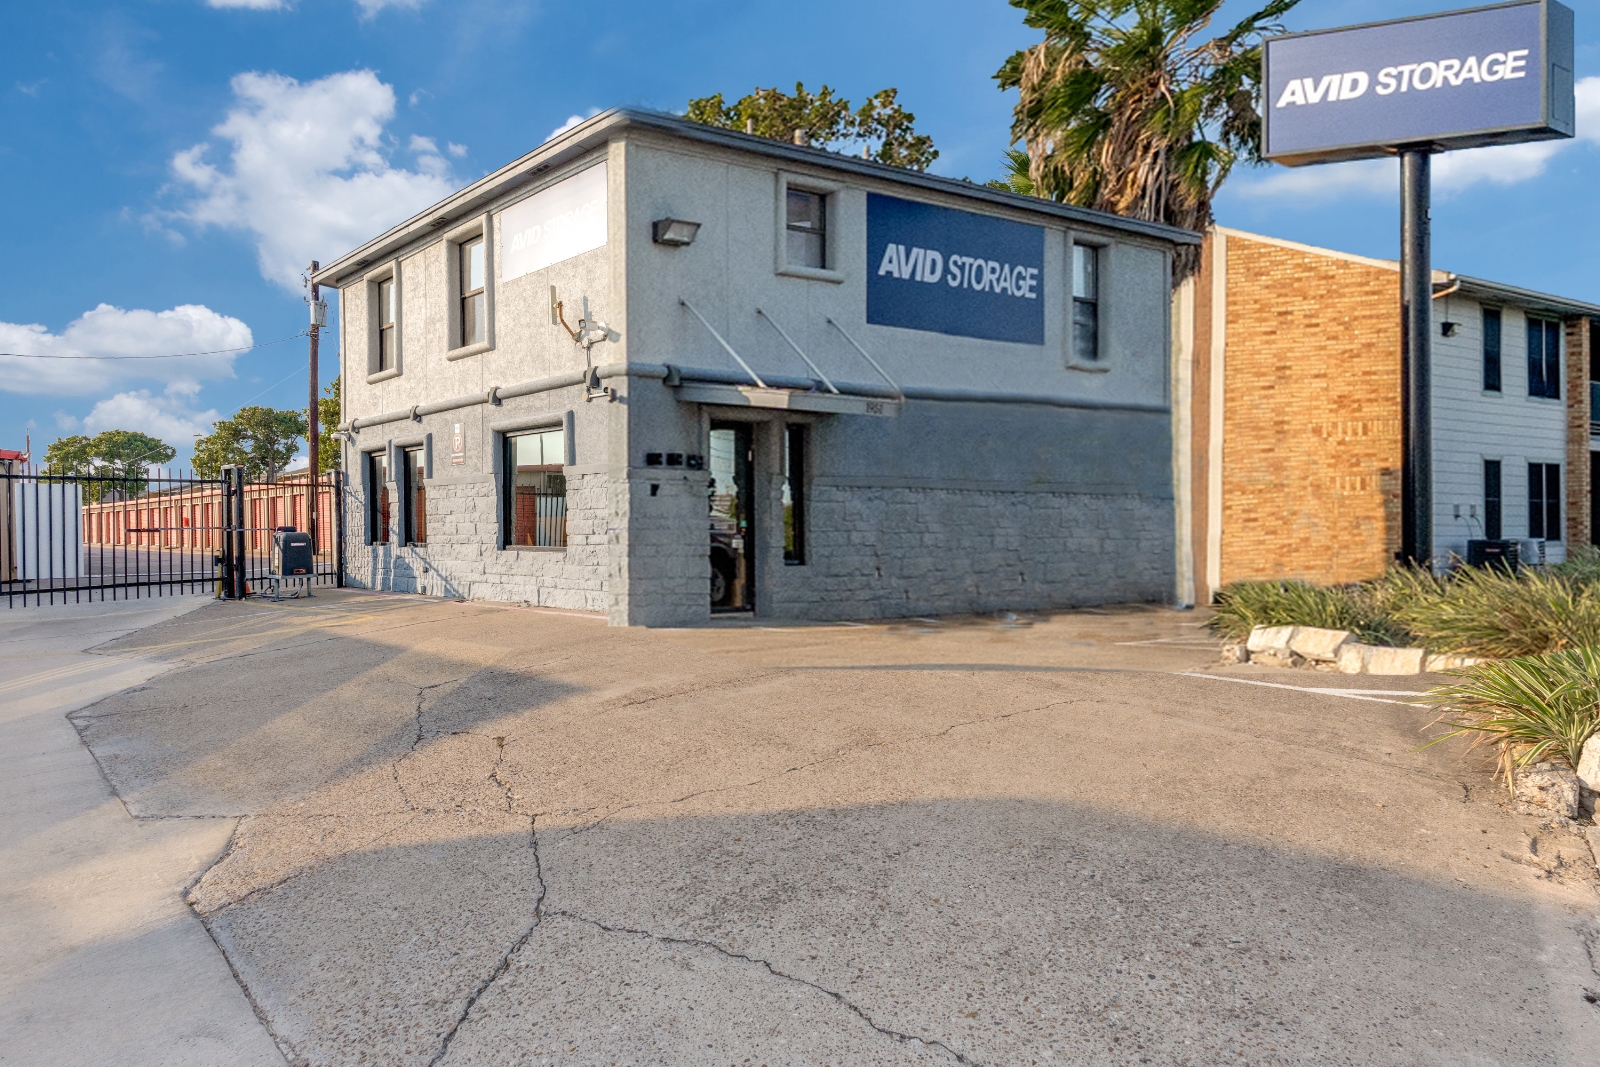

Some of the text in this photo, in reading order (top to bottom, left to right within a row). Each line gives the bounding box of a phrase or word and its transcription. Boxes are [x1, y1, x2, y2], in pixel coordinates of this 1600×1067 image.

[1276, 49, 1529, 108] AVID STORAGE
[509, 199, 599, 254] AVID STORAGE
[878, 243, 1039, 299] AVID STORAGE
